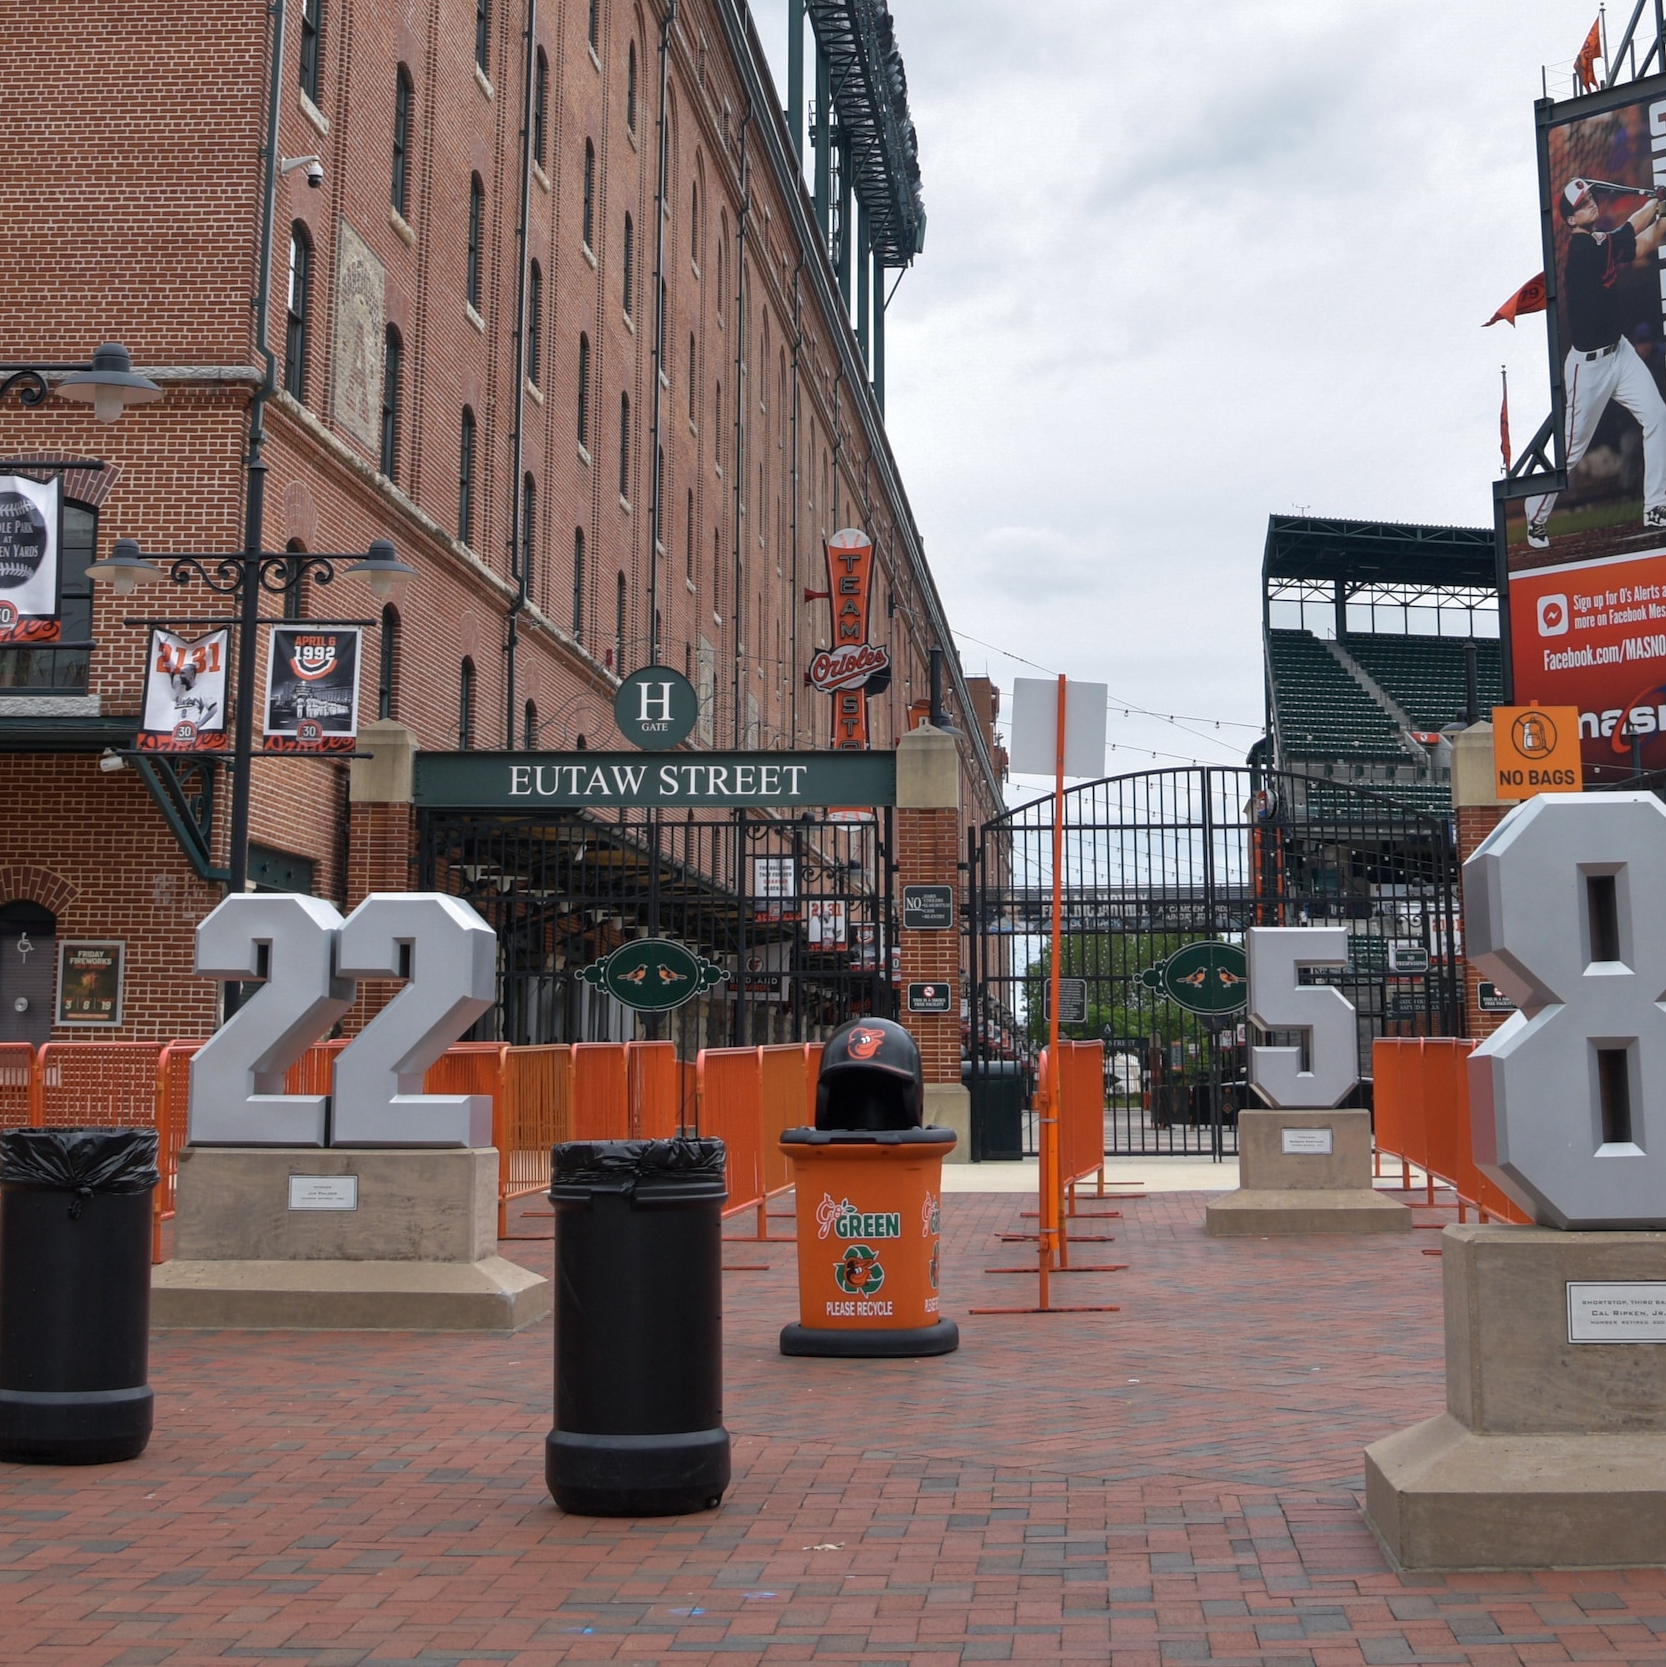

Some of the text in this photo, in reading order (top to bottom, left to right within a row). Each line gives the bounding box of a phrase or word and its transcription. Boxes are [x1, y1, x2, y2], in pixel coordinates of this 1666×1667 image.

[838, 555, 861, 639] TEAM
[1573, 594, 1591, 612] Sign
[1593, 595, 1603, 611] up
[1606, 591, 1617, 606] for
[1634, 584, 1660, 601] Alerts
[1575, 615, 1595, 630] more
[1597, 613, 1607, 626] on
[1609, 604, 1647, 624] Facebook
[294, 646, 336, 660] 1992
[295, 636, 336, 646] APRIL 6
[156, 643, 221, 674] 2131
[813, 647, 886, 682] Orioles
[635, 682, 674, 721] H
[179, 726, 191, 736] 30
[303, 726, 316, 736] 30
[642, 722, 668, 732] GATE
[509, 765, 807, 797] EUTAW STREET
[1500, 770, 1574, 785] NO BAGS
[906, 897, 921, 909] NO
[65, 1000, 72, 1009] 3
[1245, 926, 1358, 1108] 5
[187, 892, 497, 1148] 22
[835, 1212, 900, 1238] GREEN
[826, 1302, 893, 1315] PLEASE RECYCLE
